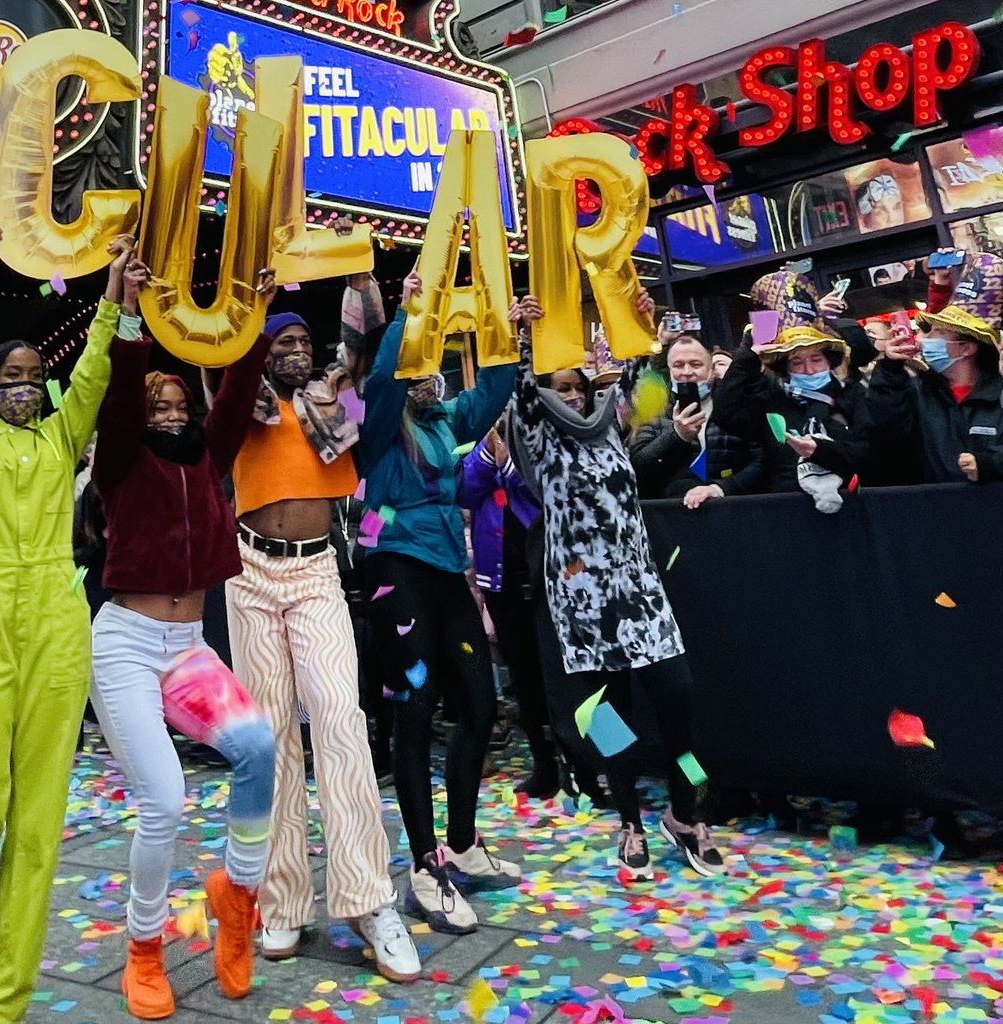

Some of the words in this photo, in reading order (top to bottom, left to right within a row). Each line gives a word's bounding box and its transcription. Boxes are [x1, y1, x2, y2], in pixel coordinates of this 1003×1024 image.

[303, 65, 360, 98] FEEL
[739, 21, 981, 147] Shop
[410, 161, 434, 192] IN
